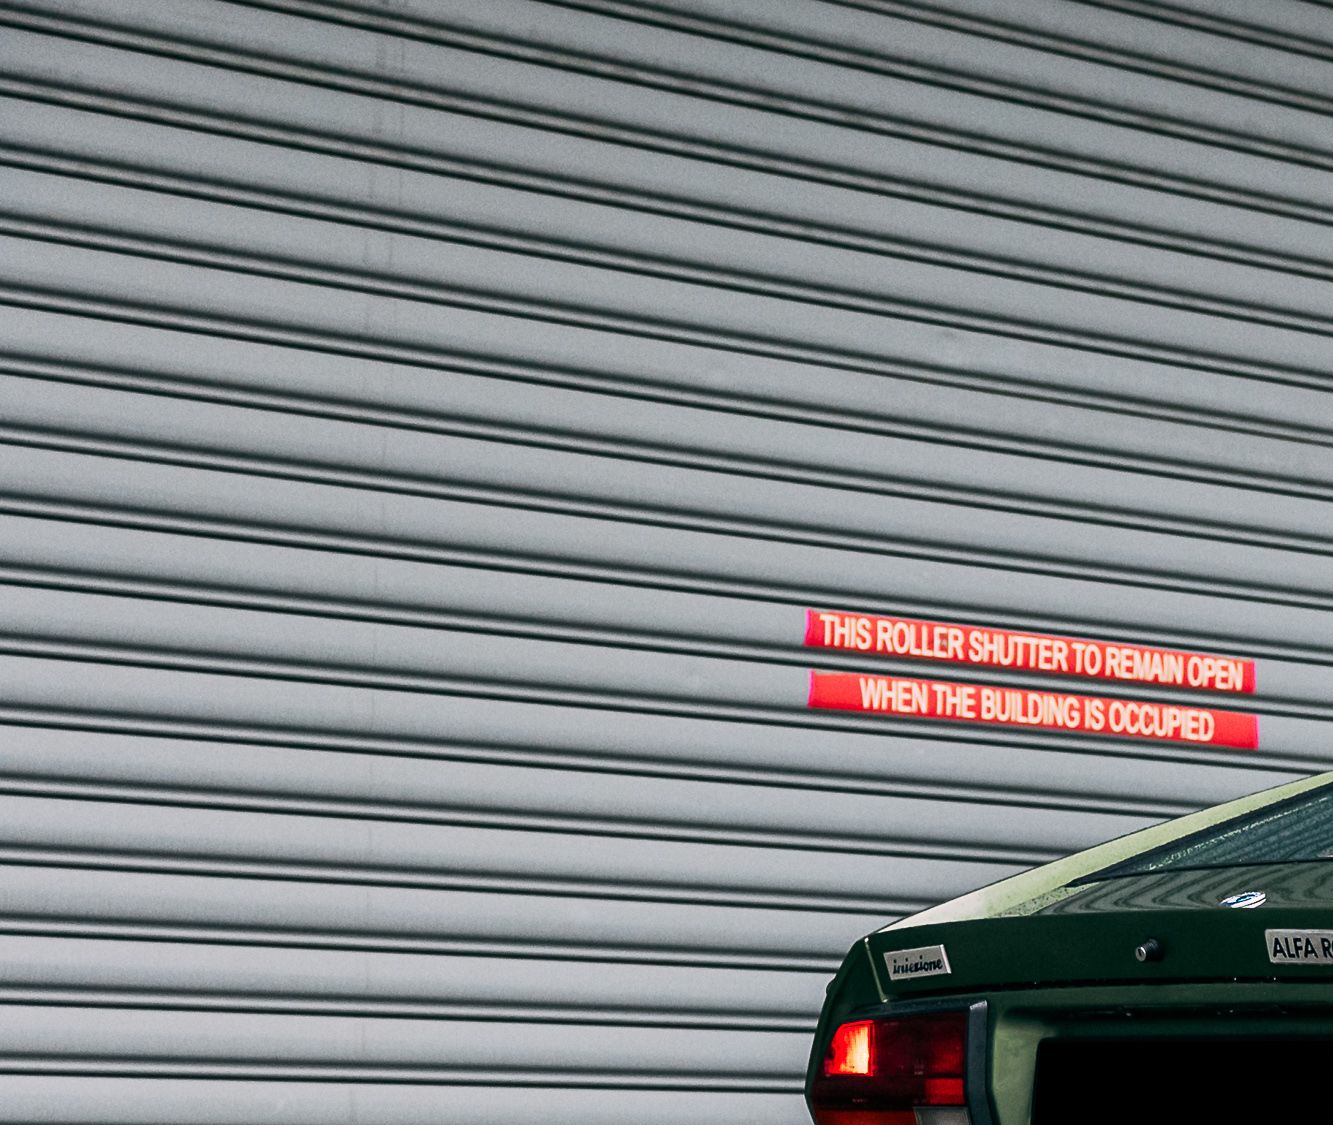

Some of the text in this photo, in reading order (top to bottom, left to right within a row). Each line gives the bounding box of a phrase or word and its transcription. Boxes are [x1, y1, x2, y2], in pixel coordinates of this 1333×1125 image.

[819, 613, 1243, 690] THIS ROLLER SHUTTER TO REMAIN OPEN
[860, 678, 1214, 741] WHEN THE BUILDING IS OCCUPIED
[1272, 937, 1318, 959] ALFA
